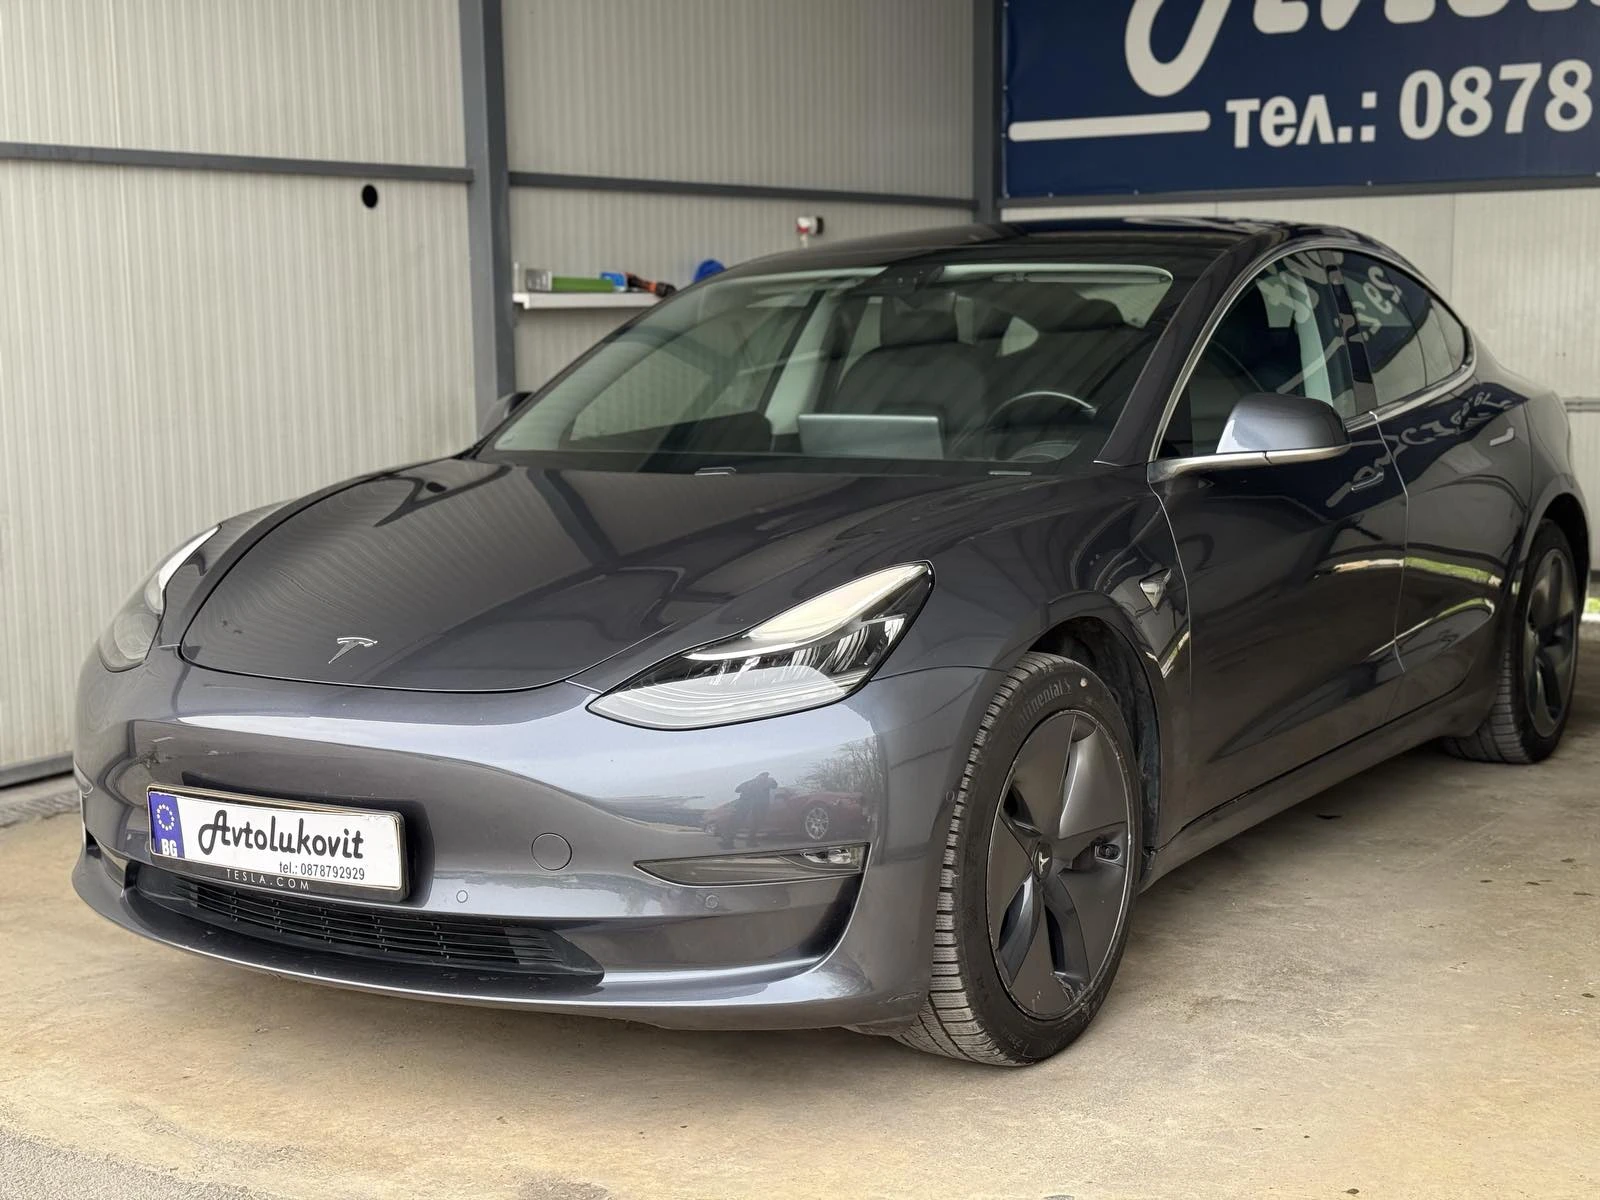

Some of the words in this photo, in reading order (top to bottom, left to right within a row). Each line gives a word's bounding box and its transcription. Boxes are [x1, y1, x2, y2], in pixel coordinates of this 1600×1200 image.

[1226, 92, 1377, 148] тел.:
[1399, 59, 1594, 140] 0878
[198, 809, 364, 859] Avtolukovit
[161, 838, 178, 857] BG
[226, 868, 311, 891] TESLA.COM
[279, 861, 298, 875] tel.:
[300, 862, 365, 881] 0878792929
